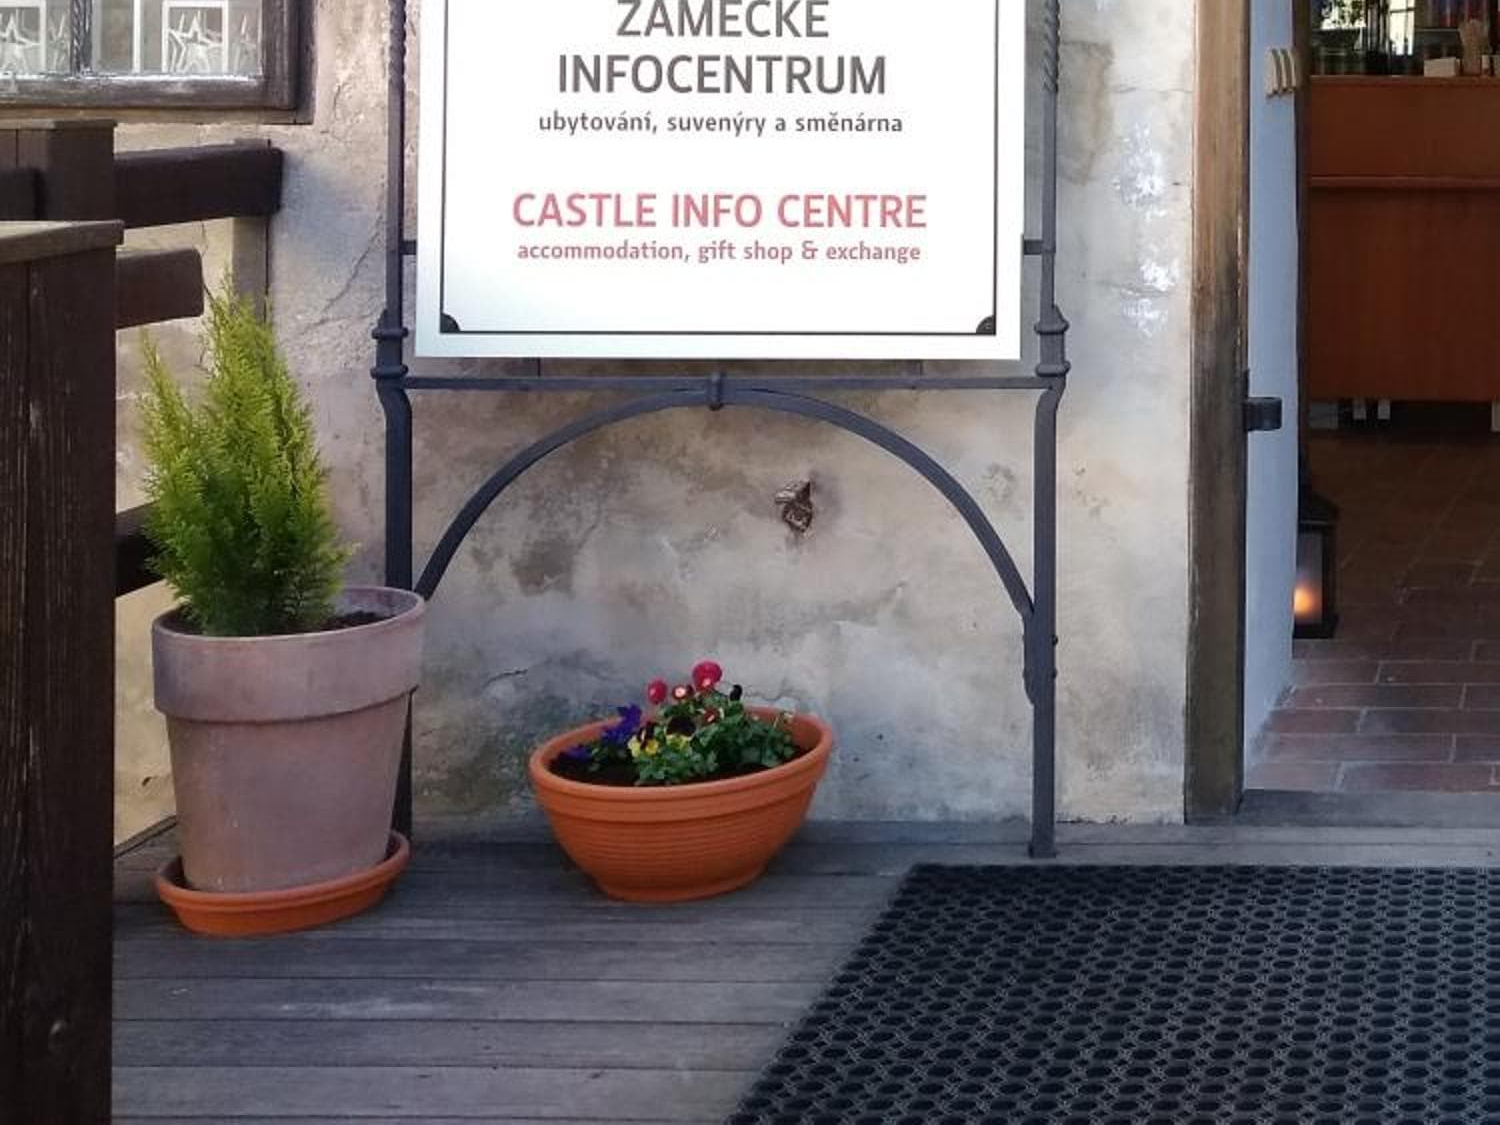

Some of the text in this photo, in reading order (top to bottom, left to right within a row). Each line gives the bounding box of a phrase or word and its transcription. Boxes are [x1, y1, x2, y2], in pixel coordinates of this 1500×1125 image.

[560, 55, 885, 94] INFOCENTRUM
[540, 110, 902, 137] ubytování, suvenýry a směnárna
[513, 193, 926, 228] CASTLE INFO CENTRE
[518, 239, 920, 265] accommodation, gift shop & exchange
